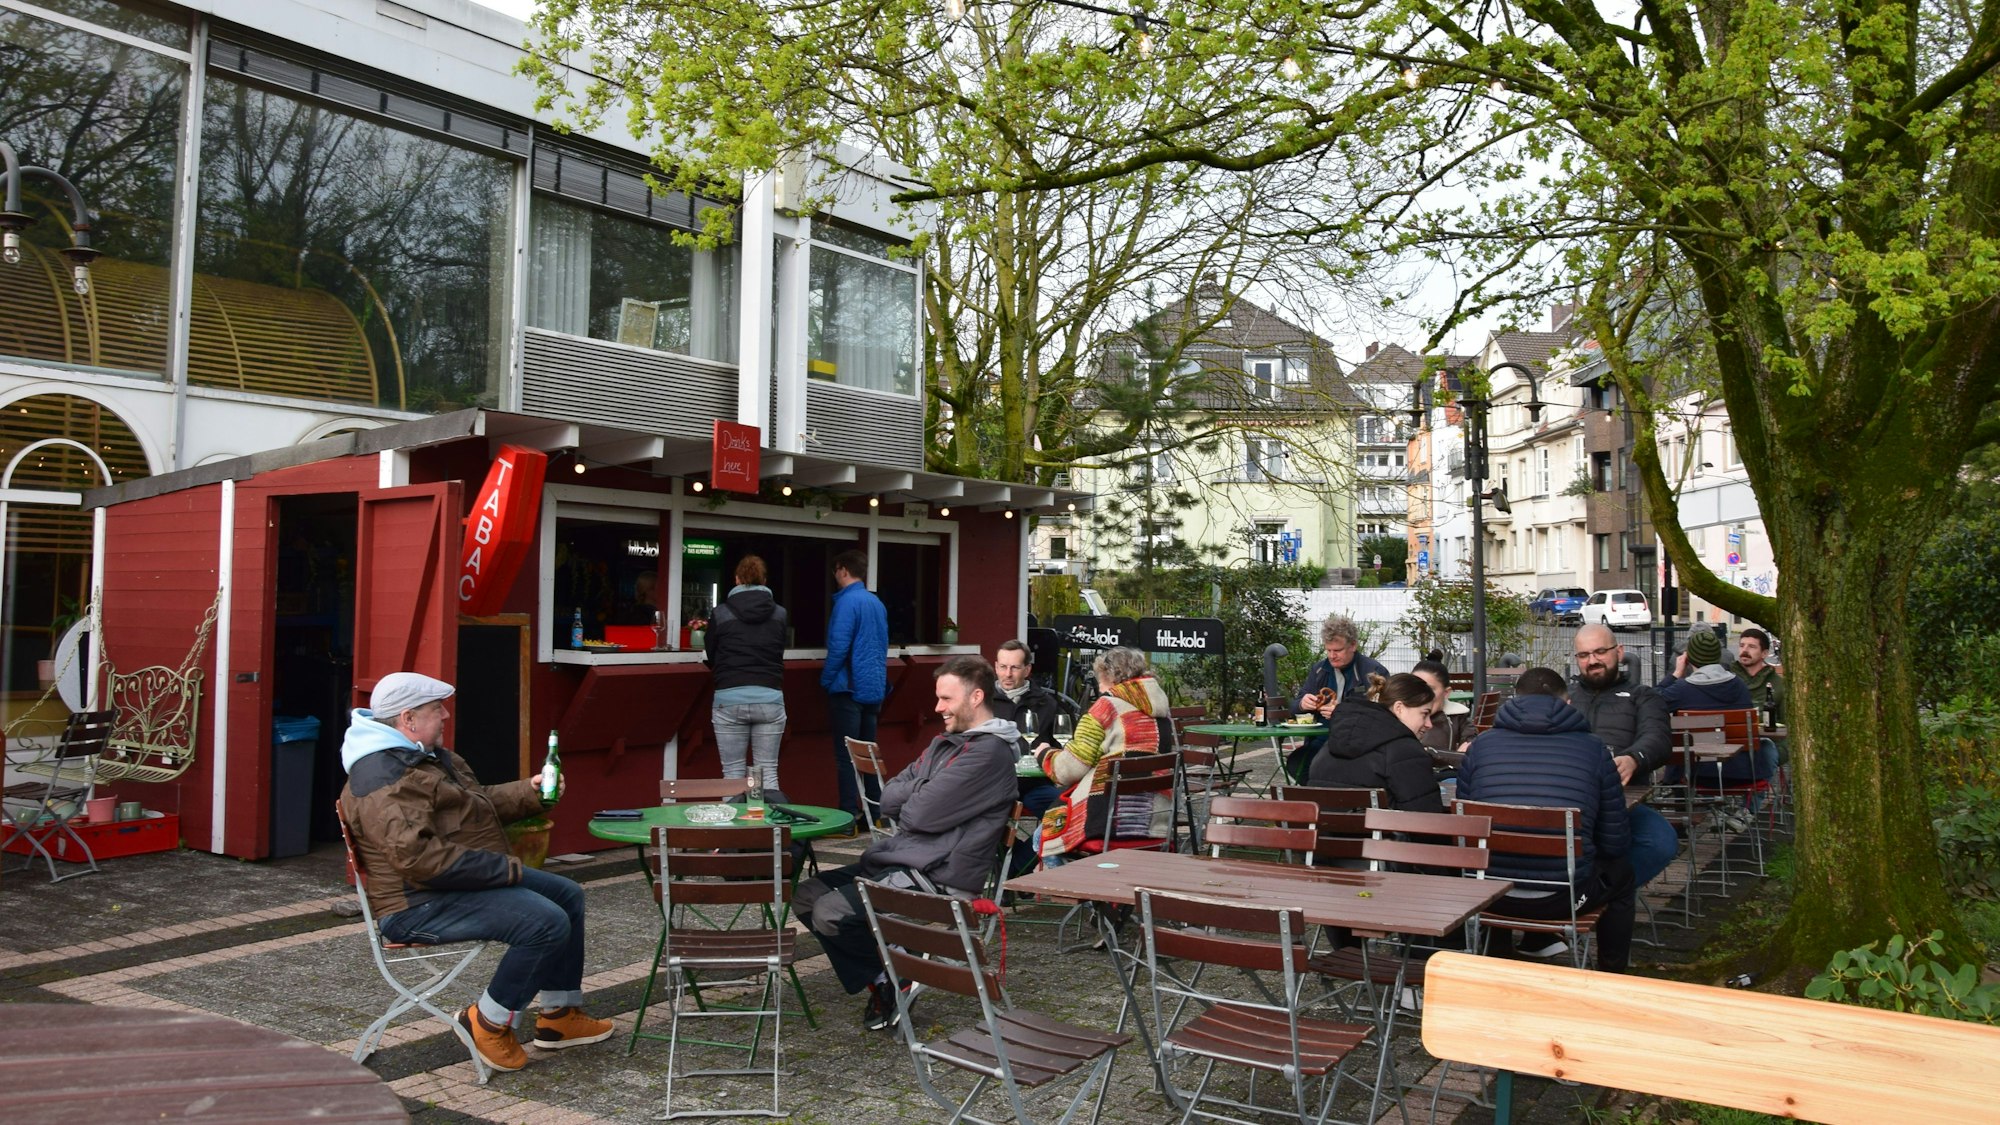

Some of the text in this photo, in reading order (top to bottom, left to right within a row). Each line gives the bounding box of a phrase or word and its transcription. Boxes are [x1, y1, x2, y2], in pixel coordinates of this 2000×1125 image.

[721, 430, 753, 451] Drinks
[458, 457, 513, 602] TABAC
[628, 540, 660, 557] fritz-kol
[1156, 629, 1205, 648] fritz-kola
